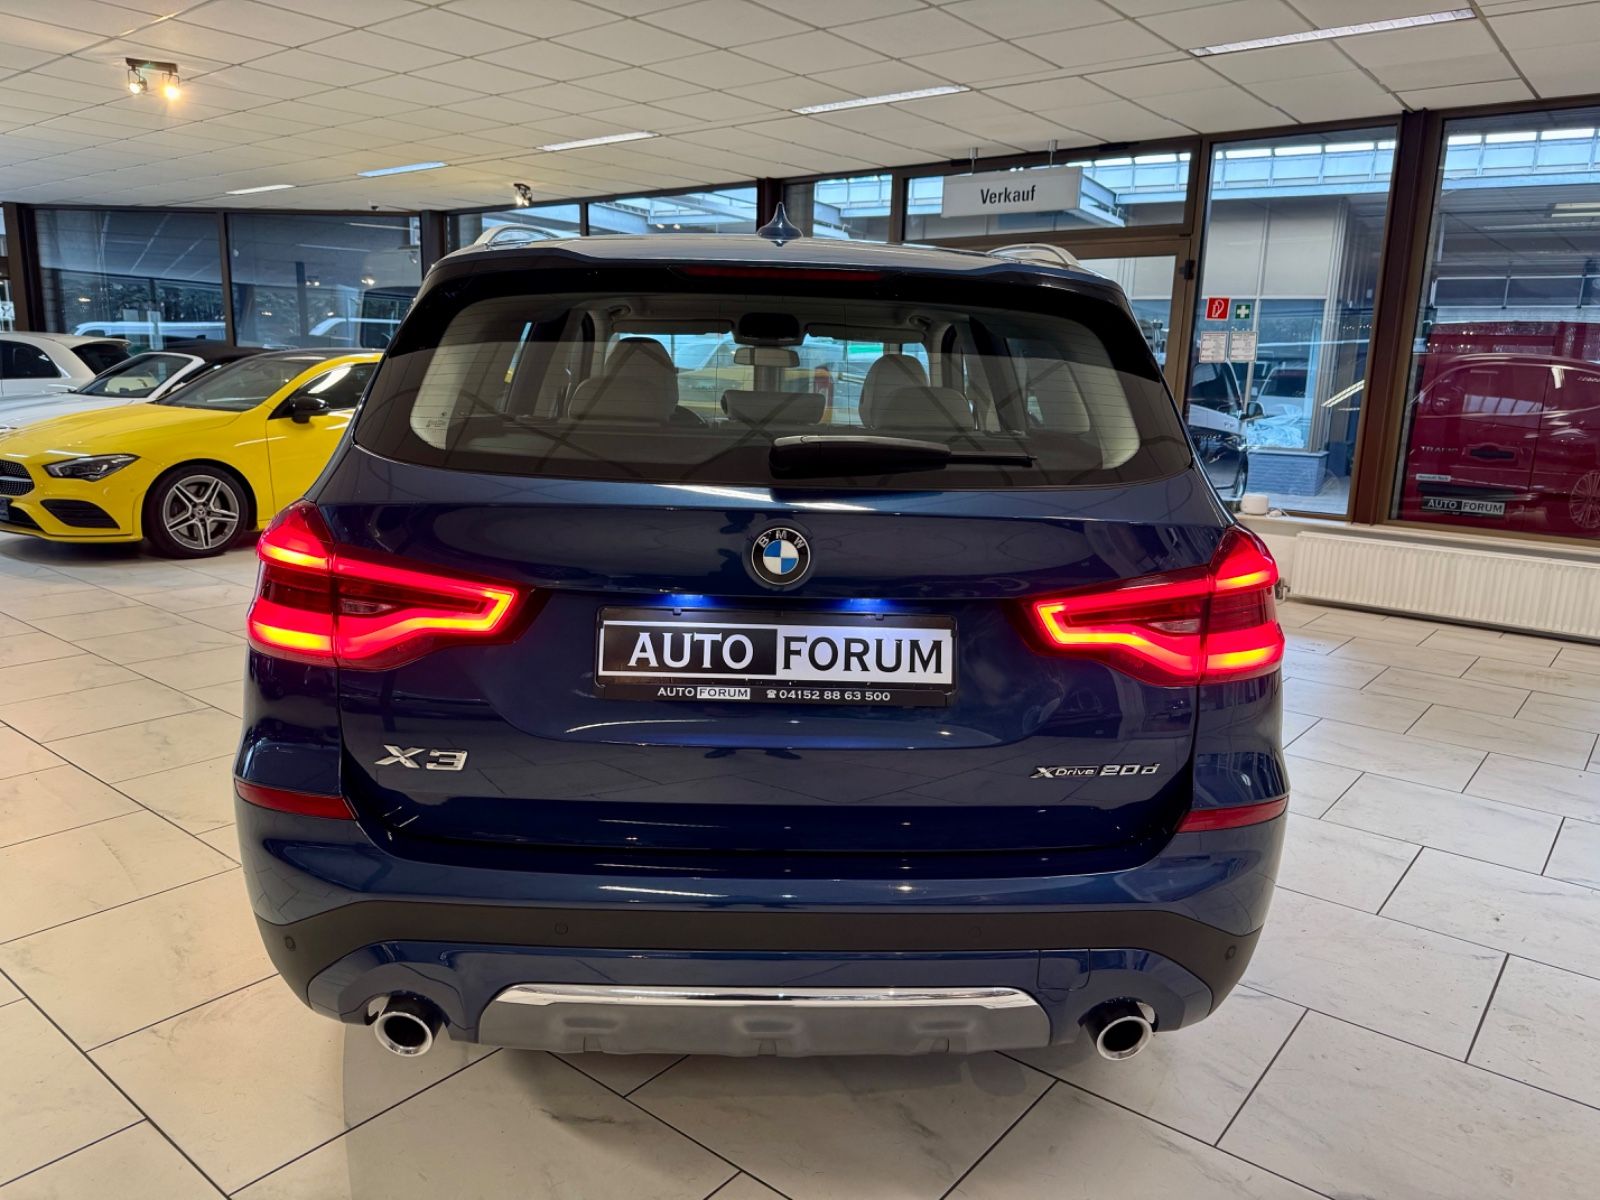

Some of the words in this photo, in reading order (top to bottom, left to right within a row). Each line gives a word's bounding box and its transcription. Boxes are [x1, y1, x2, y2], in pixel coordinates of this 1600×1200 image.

[981, 185, 1036, 204] Verkauf
[1427, 498, 1457, 509] AUTO
[1463, 502, 1503, 513] FORUM
[758, 530, 805, 549] BMW
[627, 631, 754, 671] AUTO
[782, 635, 944, 674] FORUM
[657, 687, 695, 697] AUTO
[698, 688, 749, 699] FORUM
[779, 690, 820, 700] 04152
[823, 690, 841, 700] 88
[844, 691, 862, 700] 63
[865, 691, 891, 701] 500
[374, 744, 468, 771] X3
